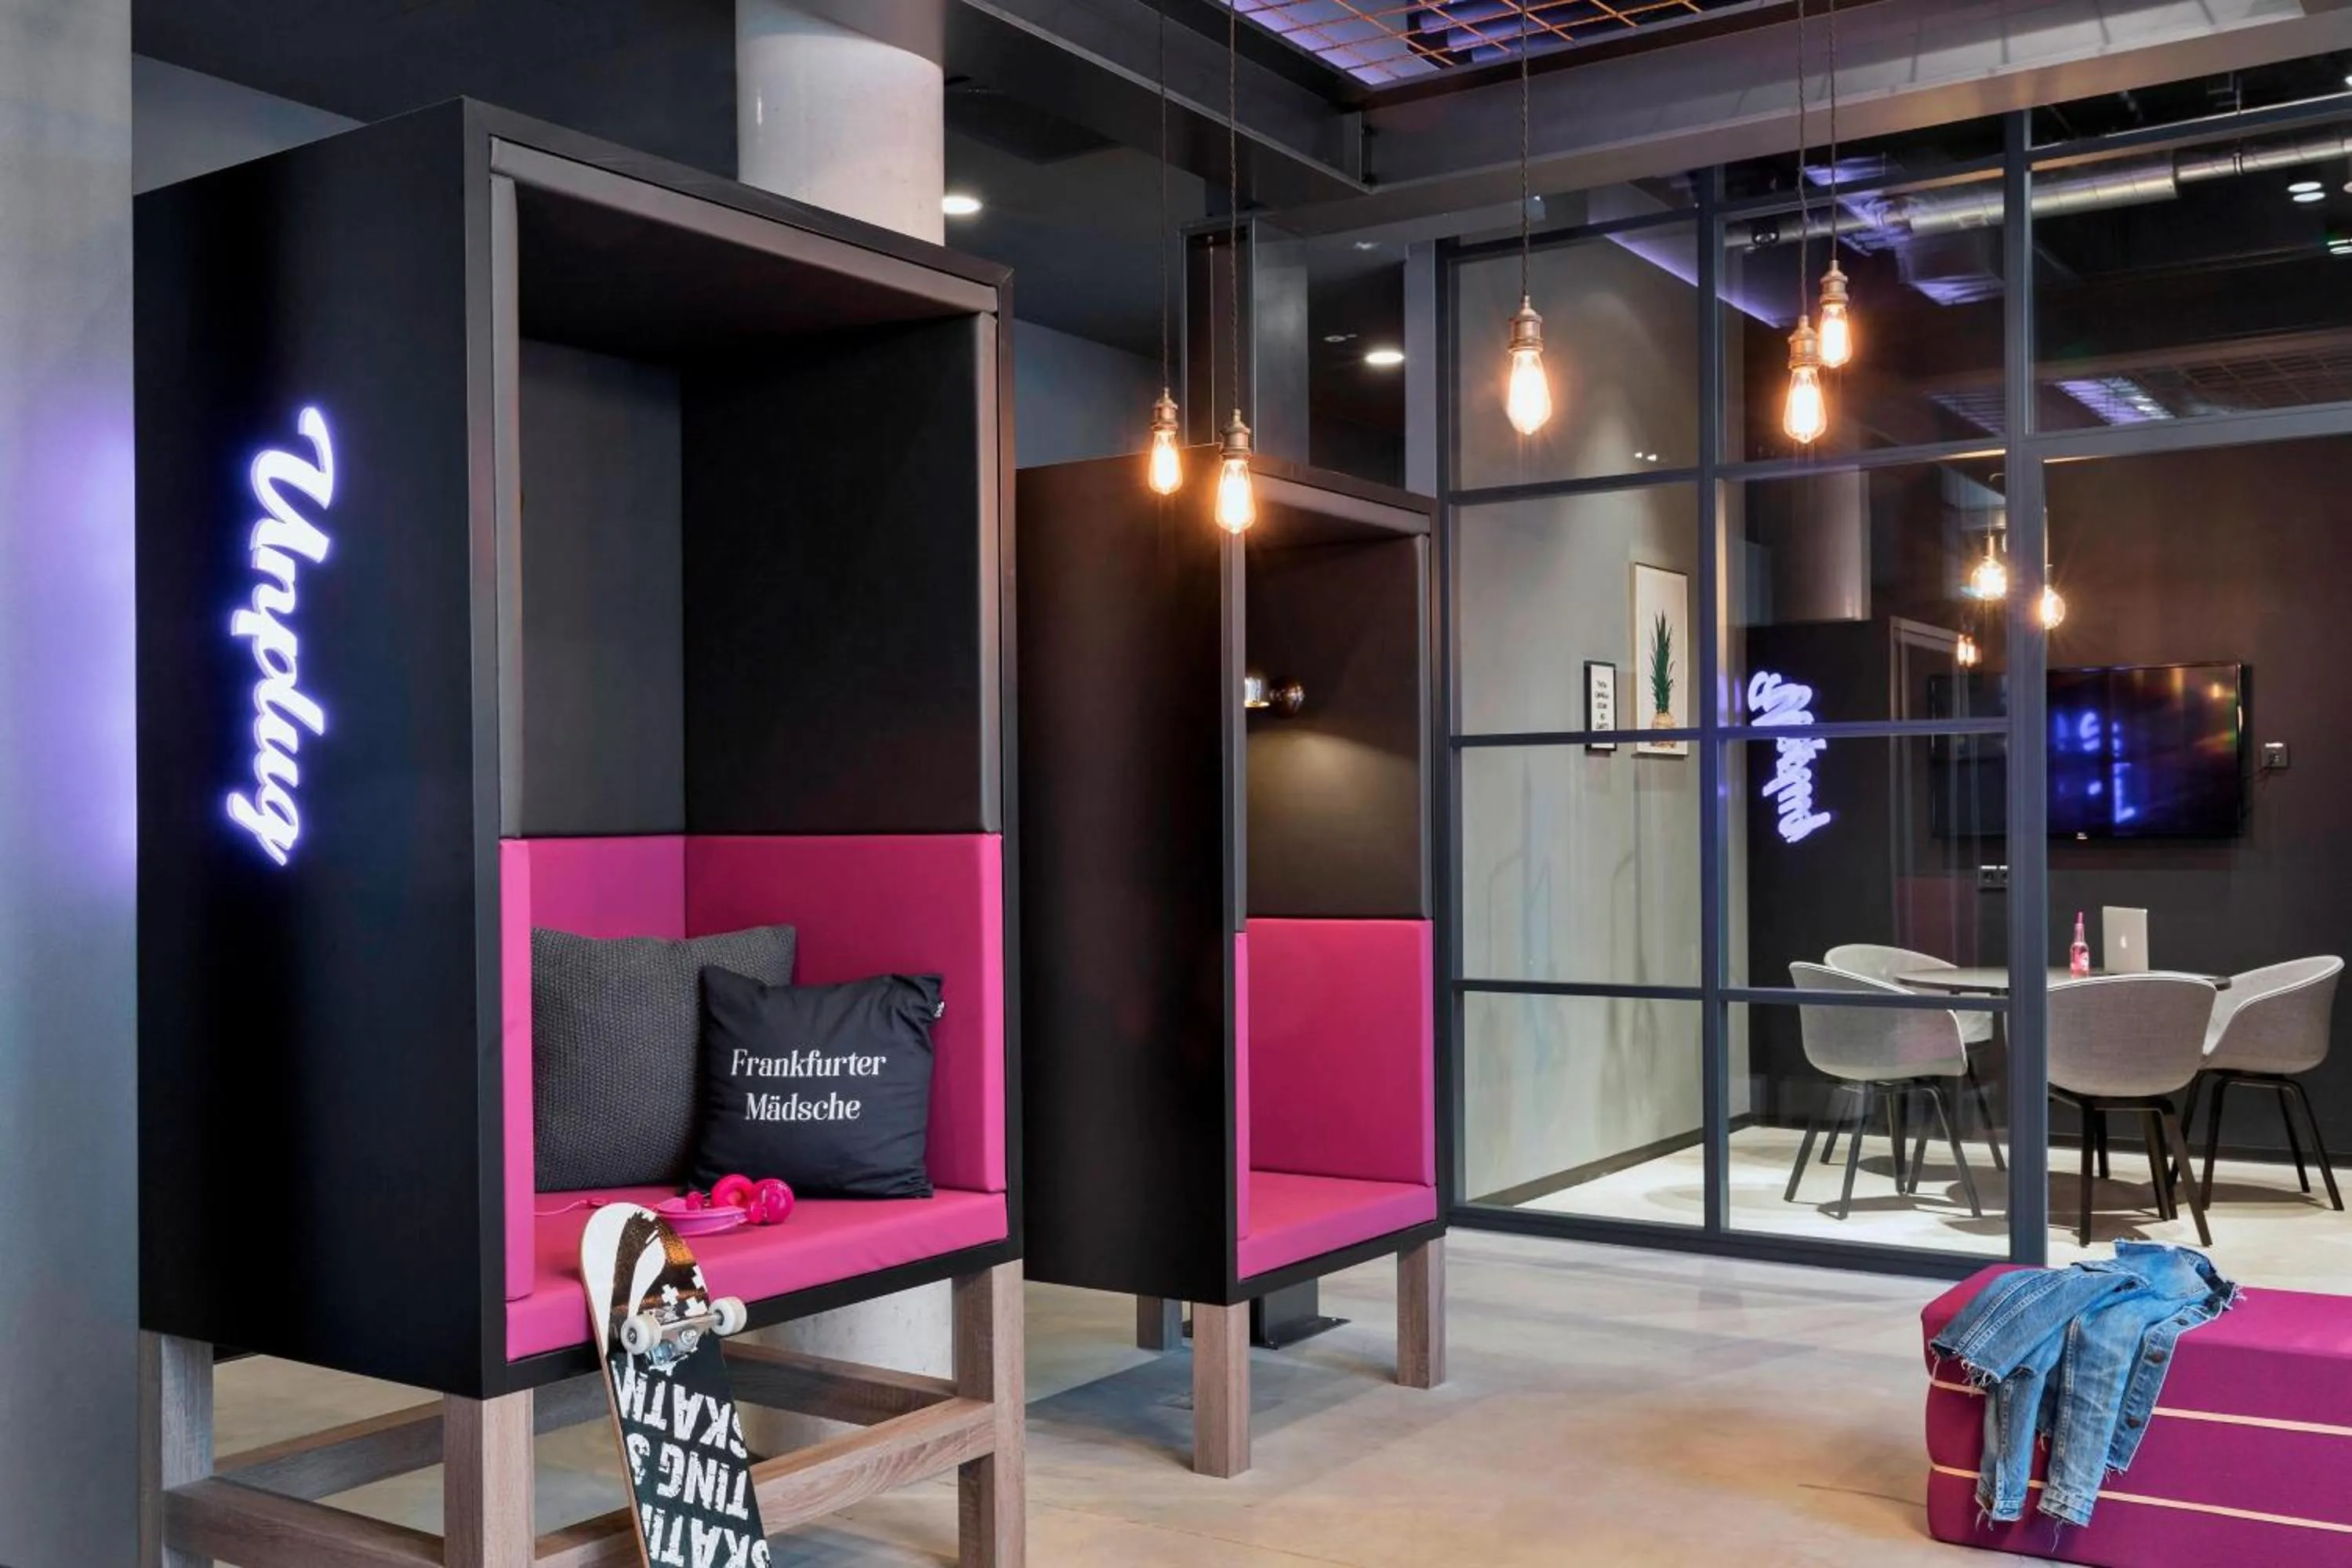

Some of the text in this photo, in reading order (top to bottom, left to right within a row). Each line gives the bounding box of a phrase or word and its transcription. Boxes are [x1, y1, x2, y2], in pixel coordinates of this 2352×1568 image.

[227, 406, 335, 866] Unplug
[730, 1048, 887, 1077] Frankfurter
[745, 1091, 862, 1121] Mädsche
[656, 1442, 749, 1520] TING
